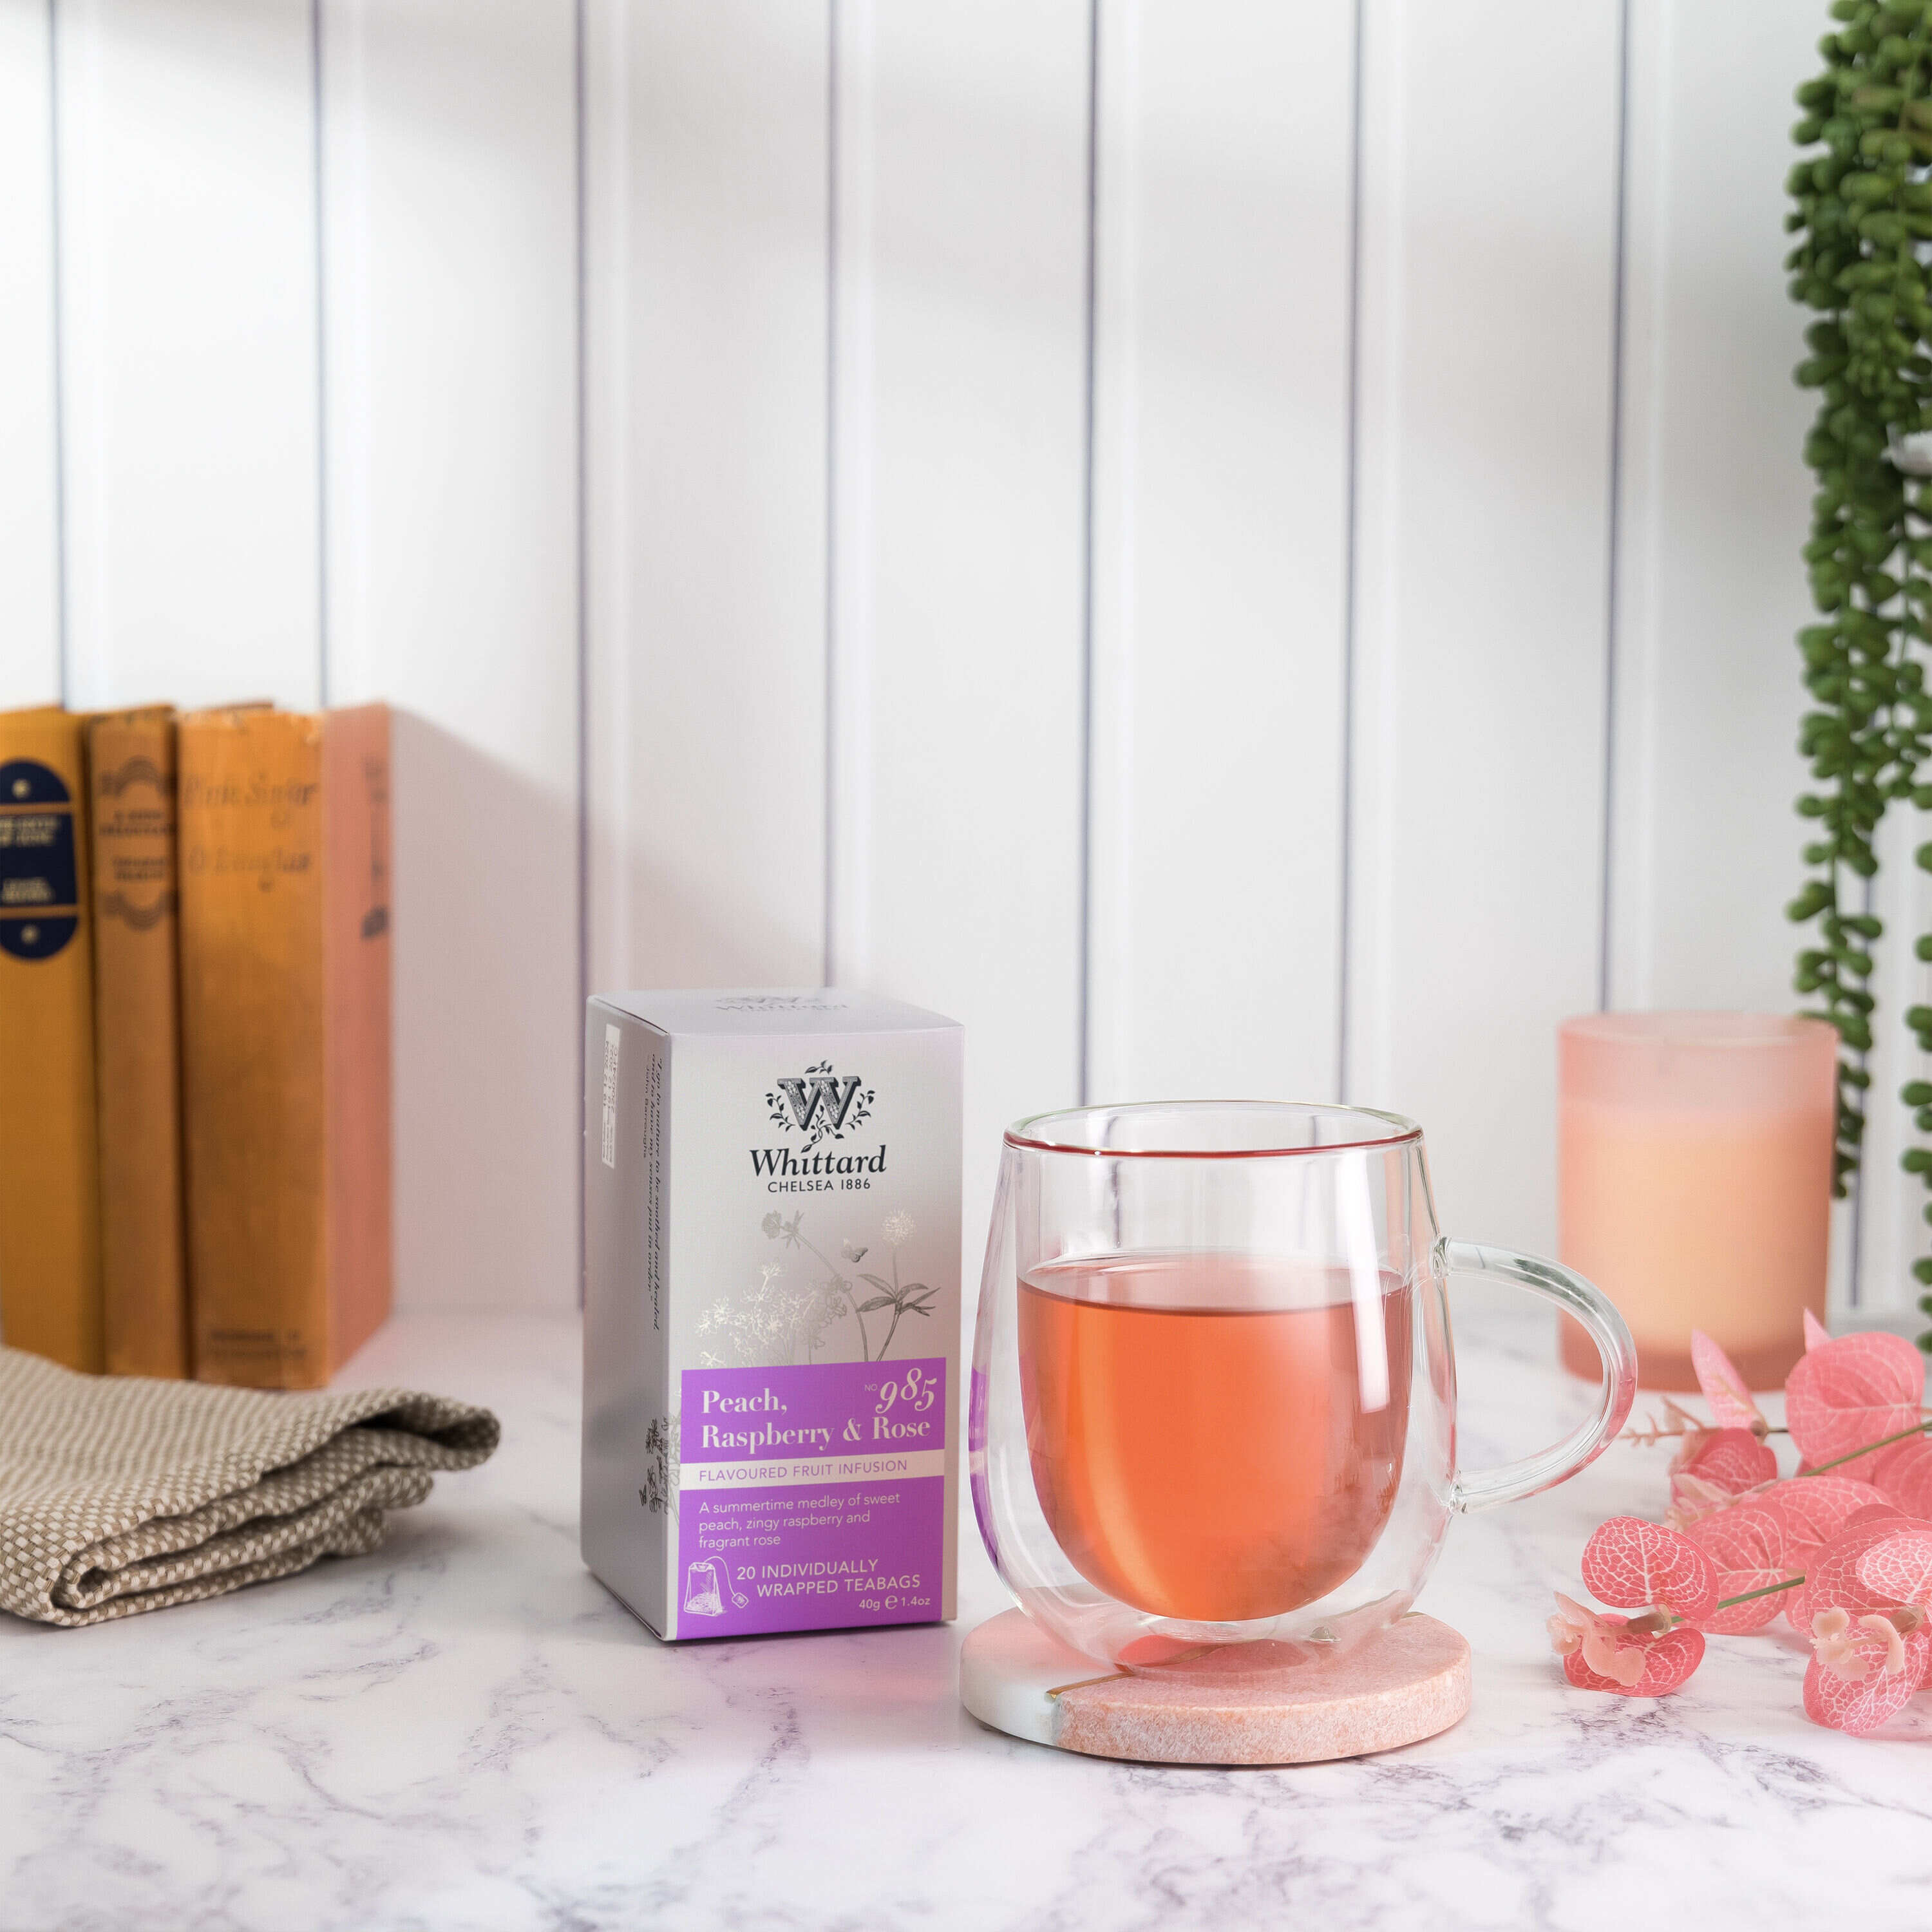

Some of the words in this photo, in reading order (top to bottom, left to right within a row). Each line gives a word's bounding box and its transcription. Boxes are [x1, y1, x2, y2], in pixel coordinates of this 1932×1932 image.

[656, 1093, 661, 1106] to
[656, 1160, 660, 1173] to
[748, 1144, 887, 1177] Whittard
[655, 1177, 660, 1192] be
[767, 1180, 834, 1193] CHELSEA
[840, 1178, 871, 1190] 1886
[701, 1388, 788, 1416] Peach,
[875, 1368, 937, 1414] 985
[701, 1422, 835, 1454] Raspberry
[842, 1417, 862, 1442] &
[872, 1416, 931, 1440] Rose
[699, 1467, 788, 1482] FLAVOURED
[793, 1464, 833, 1477] FRUIT
[838, 1459, 907, 1475] INFUSION
[699, 1502, 710, 1513] A
[713, 1499, 794, 1513] summertime
[798, 1495, 844, 1512] medley
[848, 1493, 862, 1507] of
[864, 1492, 900, 1505] sweet
[699, 1518, 742, 1535] peach,
[746, 1517, 779, 1531] zingy
[783, 1512, 842, 1528] raspberry
[846, 1510, 870, 1524] and
[699, 1535, 750, 1551] fragrant
[753, 1535, 781, 1546] rose
[736, 1566, 756, 1580] 20
[762, 1558, 879, 1578] INDIVIDUALLY
[756, 1580, 838, 1598] WRAPPED
[844, 1574, 921, 1592] TEABAGS
[858, 1599, 880, 1611] 40g
[900, 1596, 931, 1607] 1.4oz
